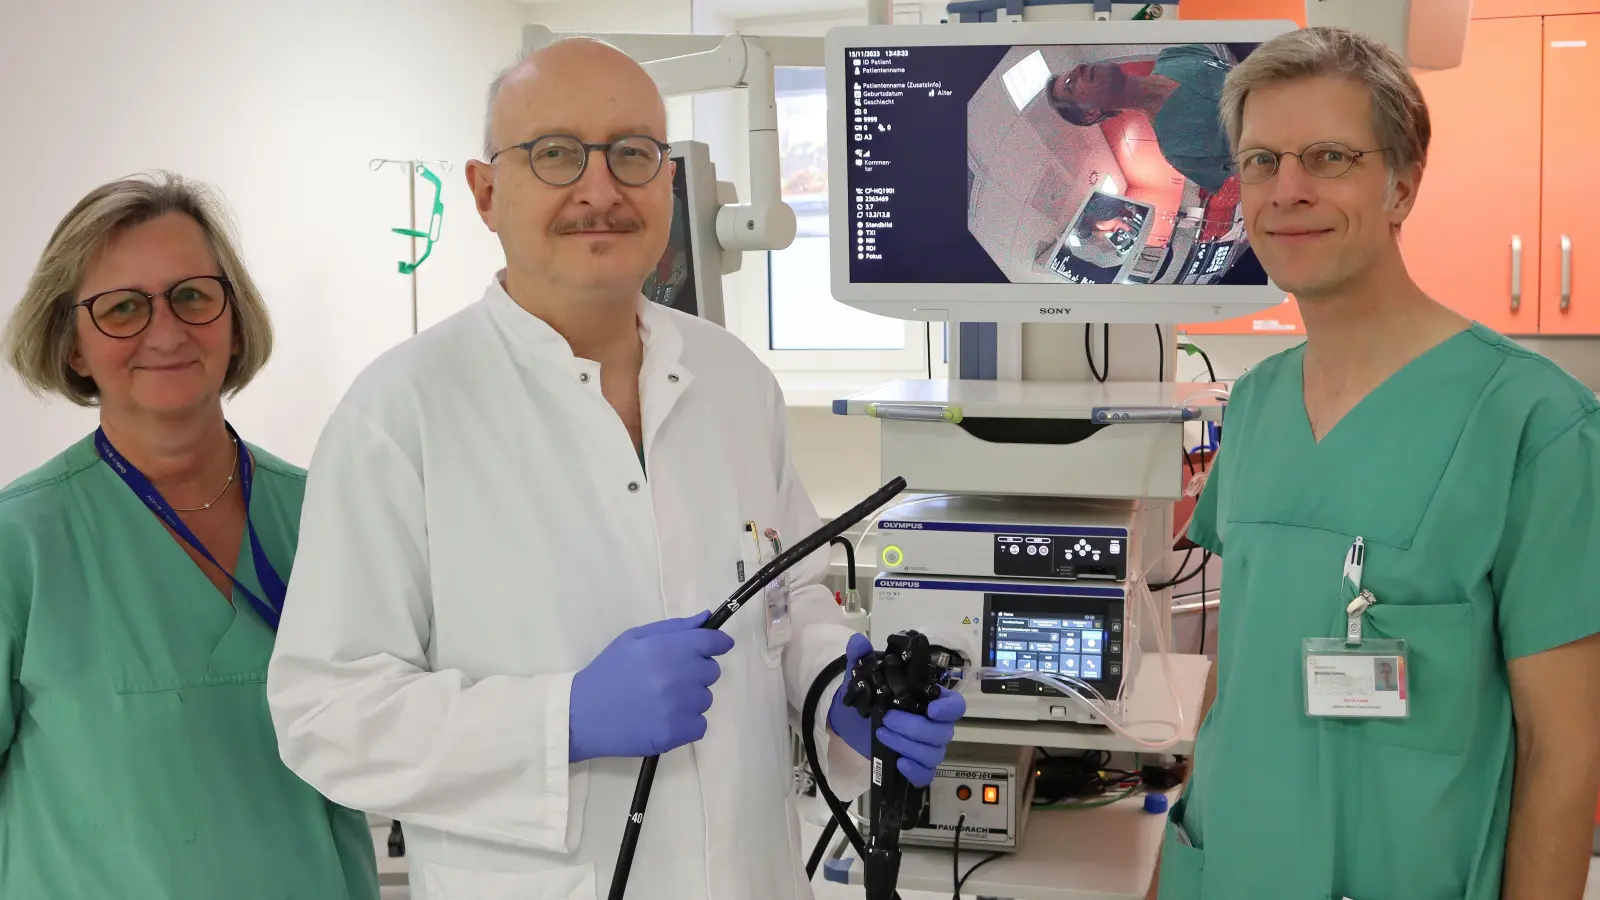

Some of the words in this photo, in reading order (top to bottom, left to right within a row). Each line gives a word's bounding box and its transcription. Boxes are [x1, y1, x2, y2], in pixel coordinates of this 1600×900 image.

[883, 522, 923, 530] OLYMPUS
[880, 580, 920, 588] OLYMPUS
[727, 599, 740, 611] 20
[955, 771, 991, 780] endo-jet
[631, 812, 643, 824] 40
[938, 825, 988, 833] PAUDRACH
